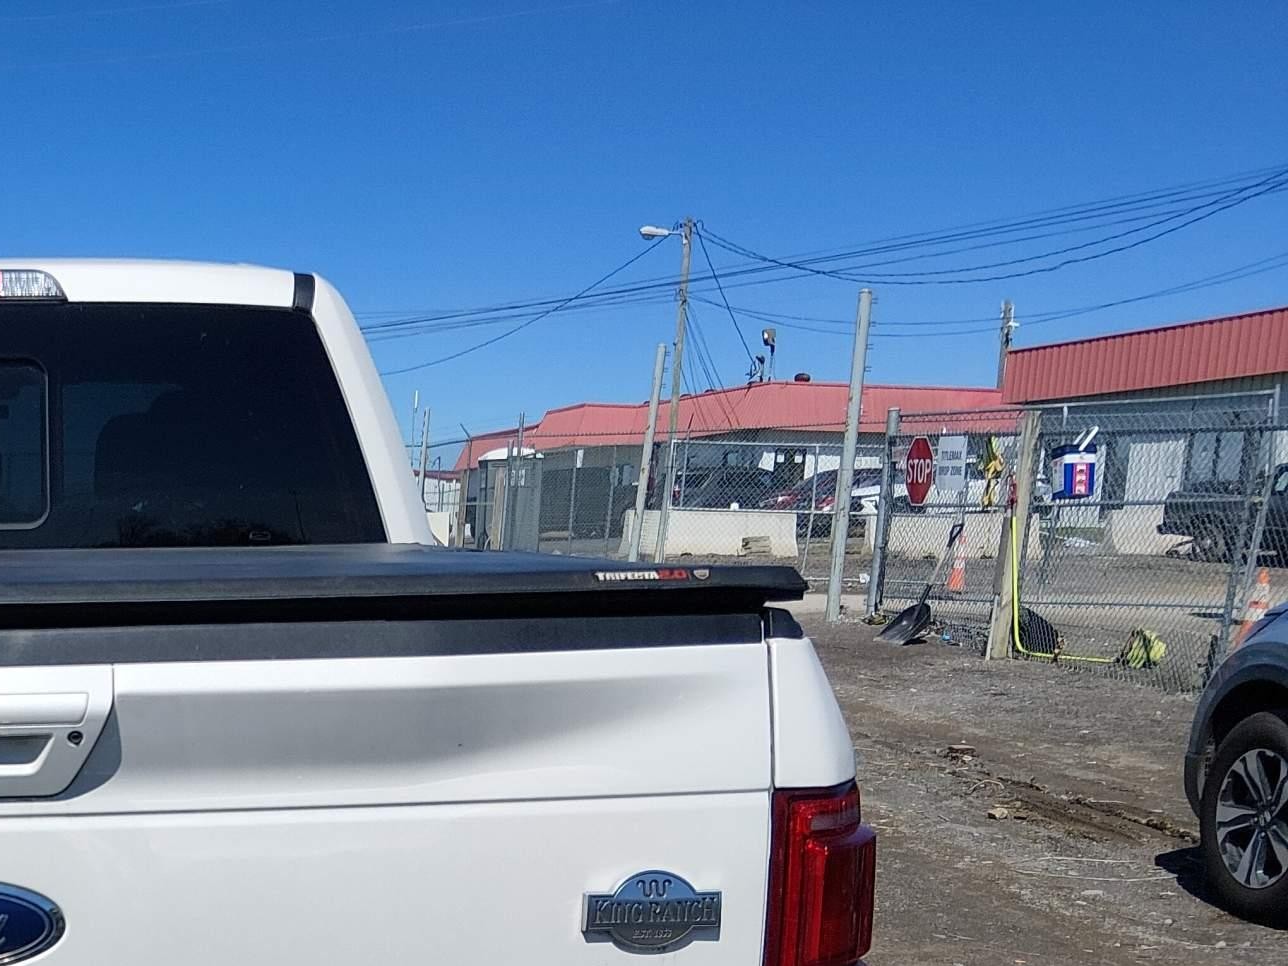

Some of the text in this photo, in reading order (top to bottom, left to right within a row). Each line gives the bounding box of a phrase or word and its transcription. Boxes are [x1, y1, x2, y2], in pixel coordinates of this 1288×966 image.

[907, 458, 932, 484] STOP
[594, 571, 660, 581] TRIFECTA
[592, 896, 718, 924] KING RANCH
